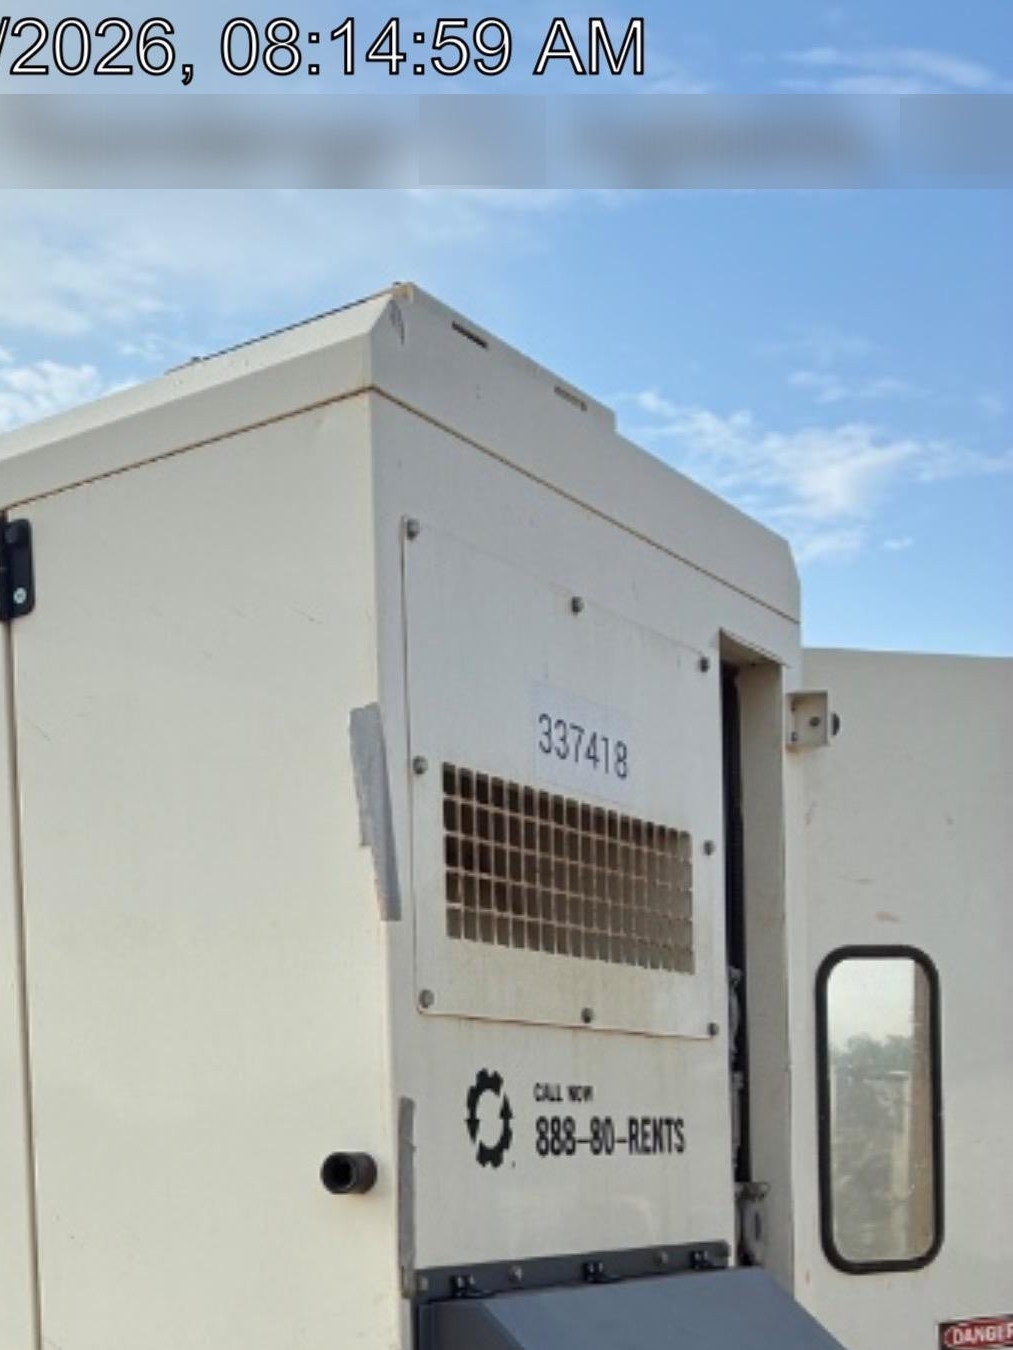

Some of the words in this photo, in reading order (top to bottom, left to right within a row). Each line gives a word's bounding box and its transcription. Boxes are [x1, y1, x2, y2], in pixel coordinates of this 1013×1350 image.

[539, 713, 628, 780] 337418
[533, 1082, 564, 1103] CALL
[535, 1114, 686, 1157] 888-80-RENTS
